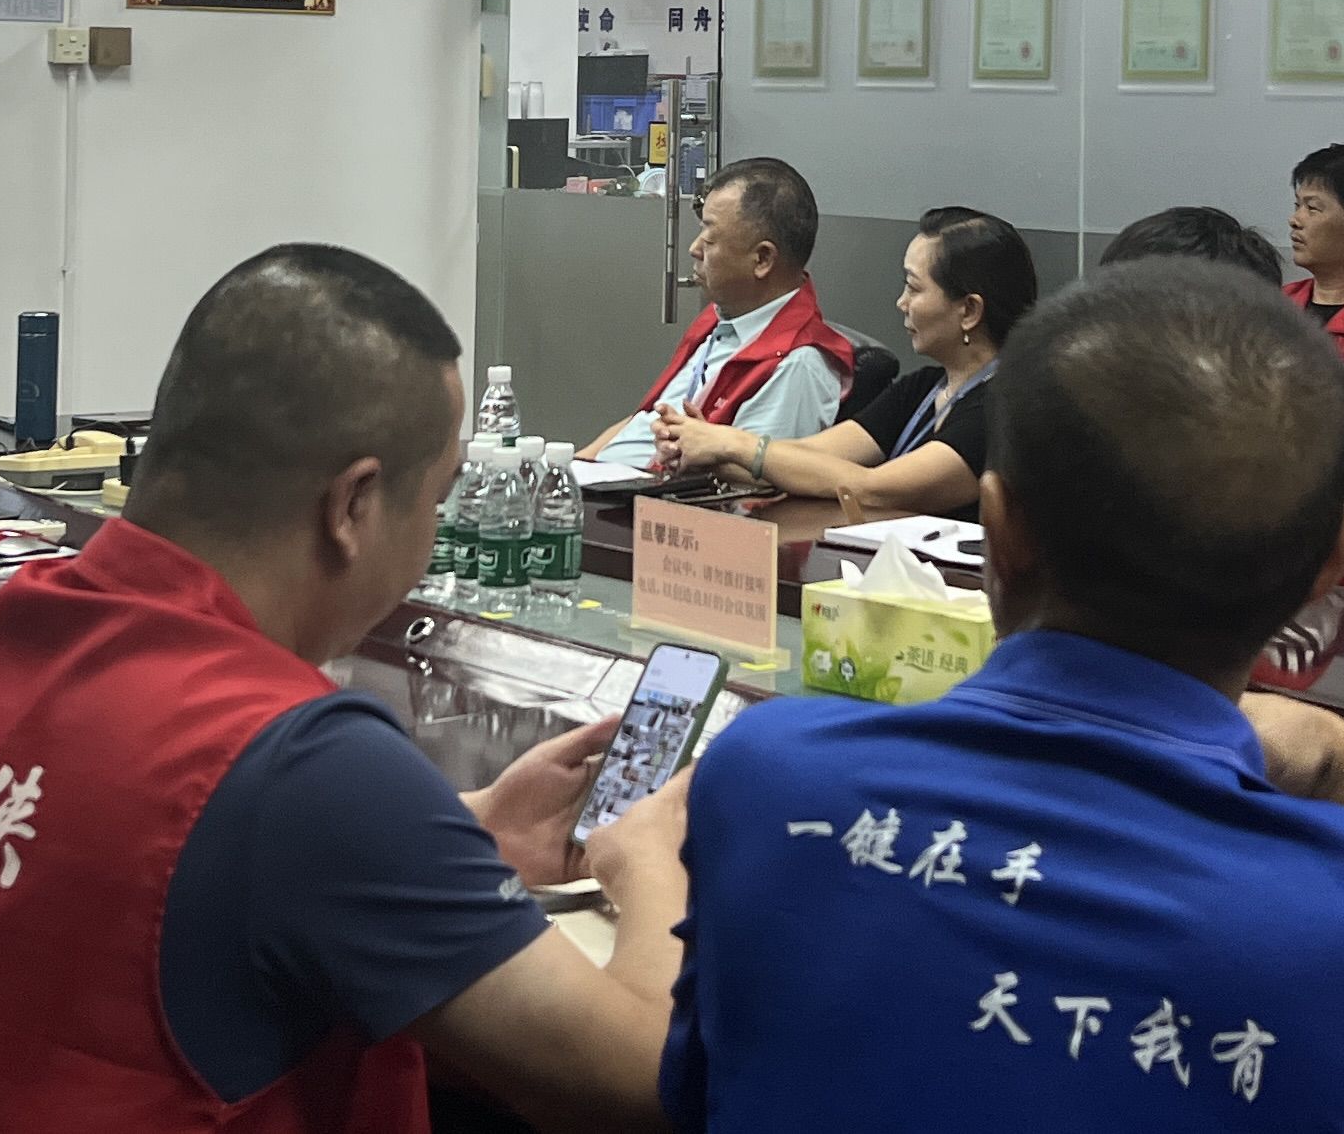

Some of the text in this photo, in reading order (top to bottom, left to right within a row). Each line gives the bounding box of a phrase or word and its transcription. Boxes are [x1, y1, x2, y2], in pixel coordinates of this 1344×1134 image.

[786, 806, 1045, 906] 一键在手
[970, 970, 1278, 1102] 天下我有
